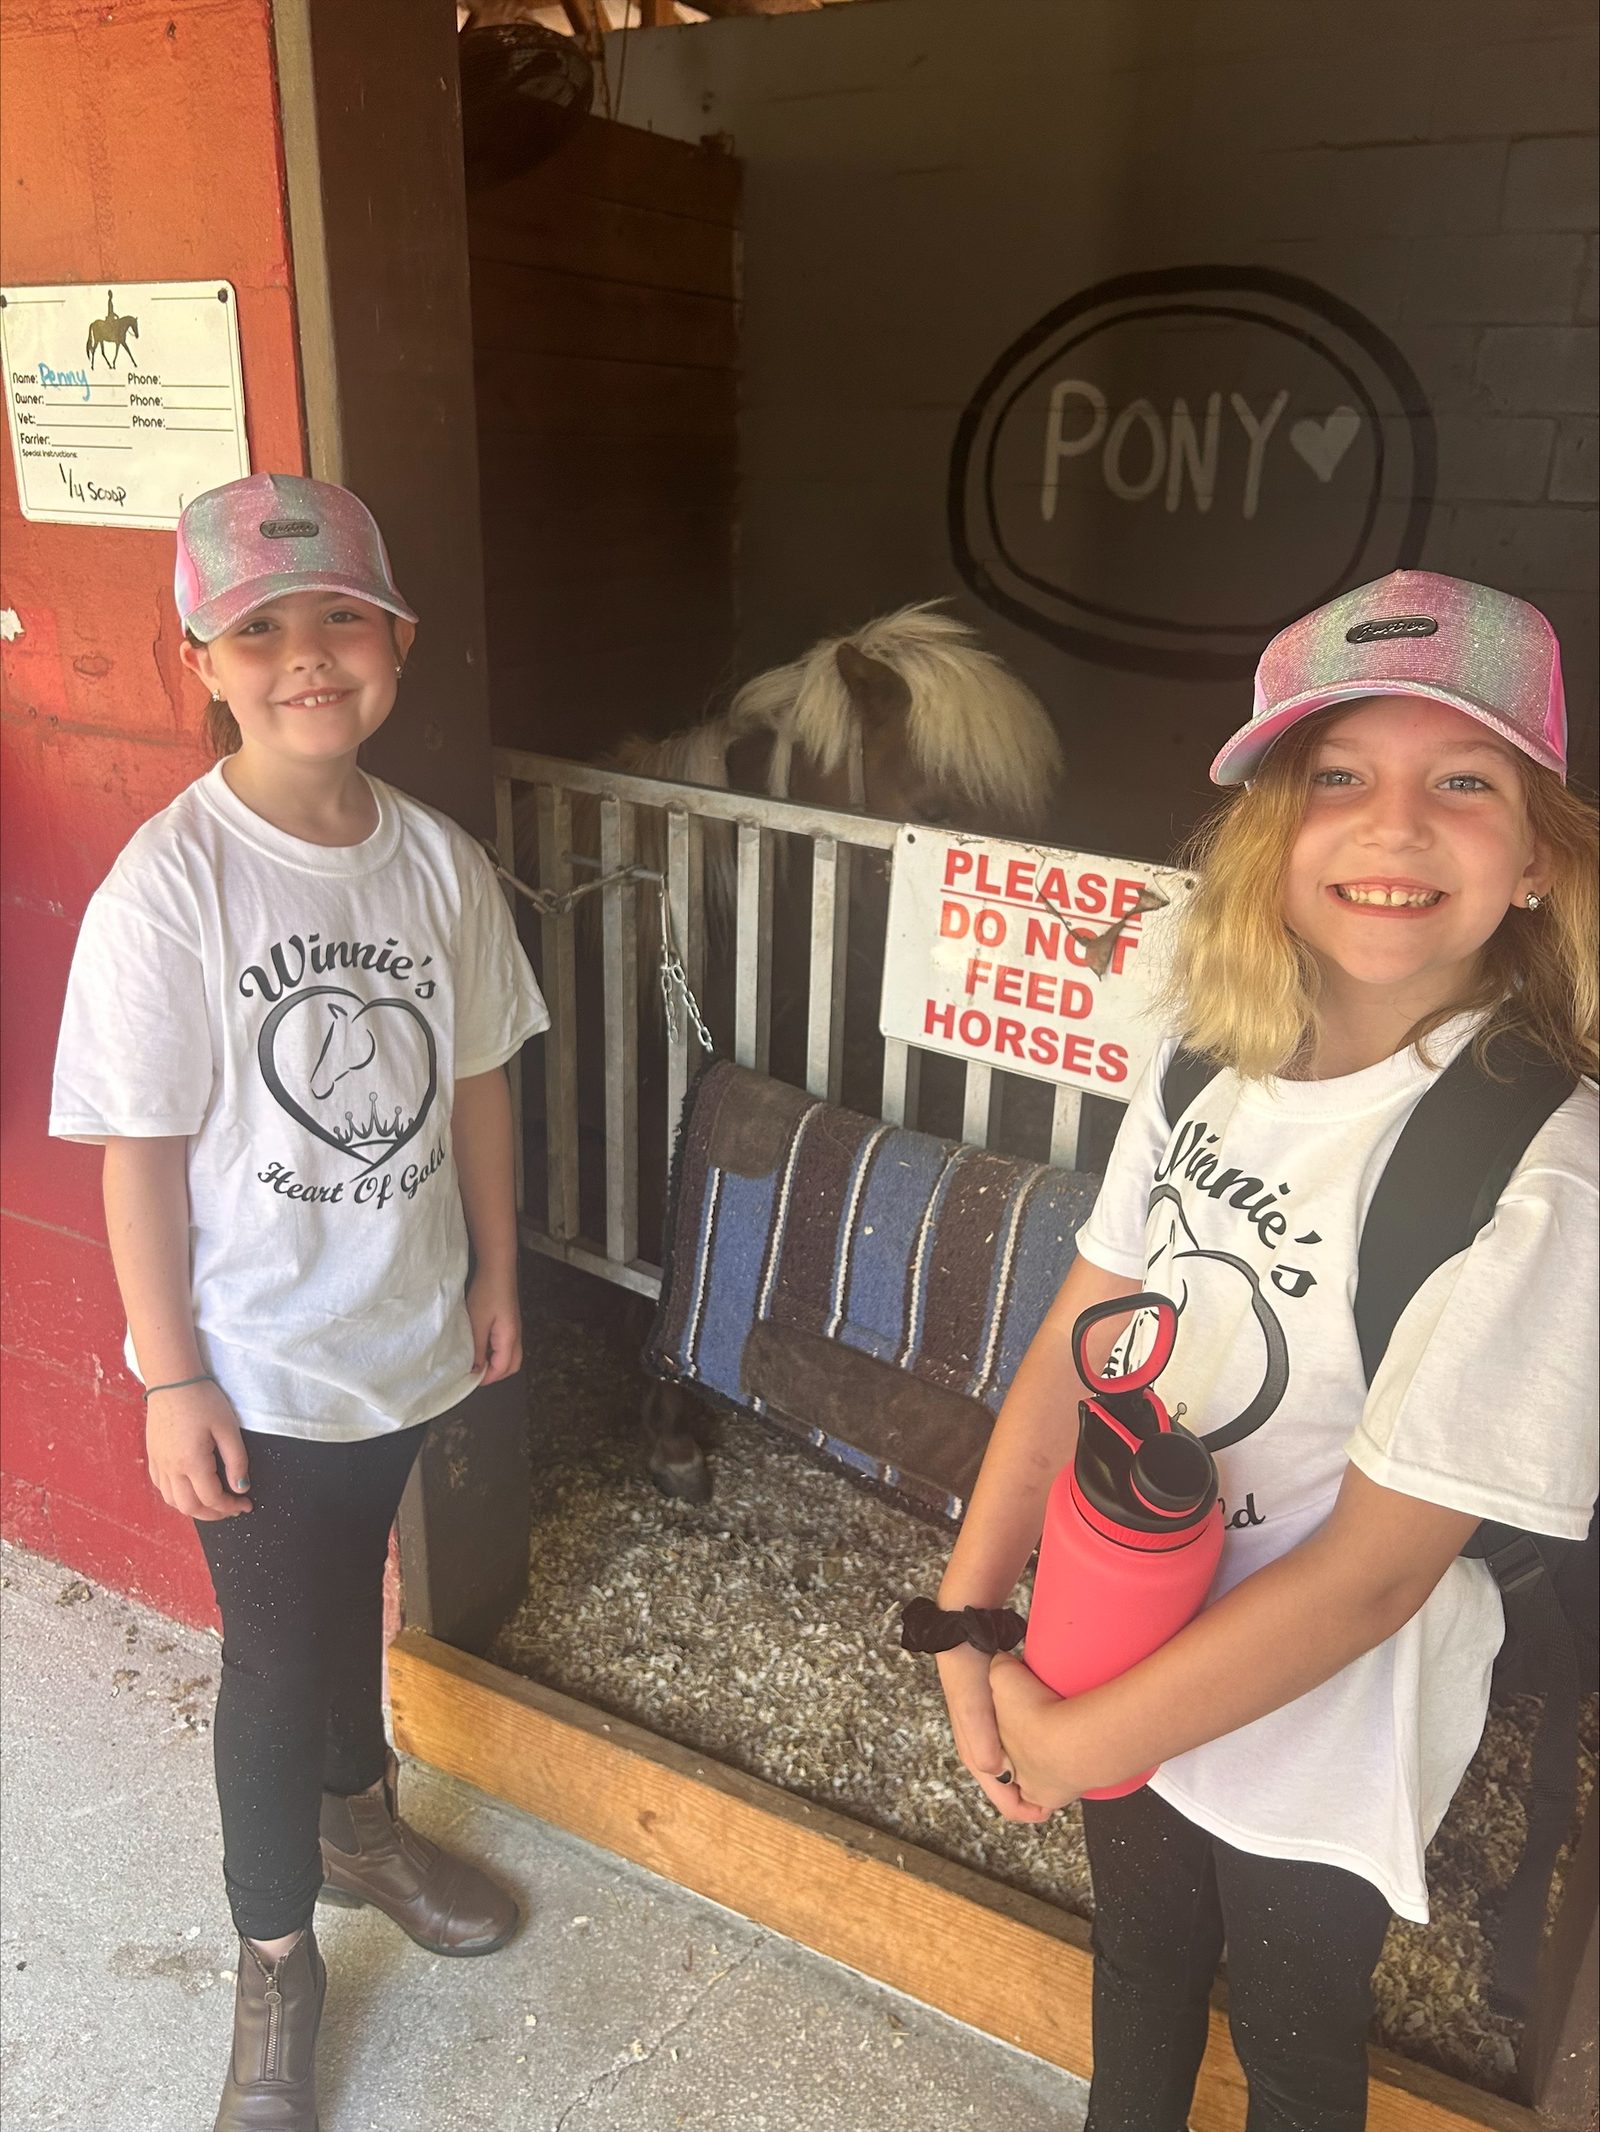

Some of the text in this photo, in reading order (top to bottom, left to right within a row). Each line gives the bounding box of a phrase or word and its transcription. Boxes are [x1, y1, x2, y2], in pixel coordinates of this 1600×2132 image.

[15, 392, 44, 405] Owner:
[38, 361, 91, 402] Penny
[127, 372, 161, 385] Phone:
[130, 393, 163, 407] Phone:
[17, 412, 36, 425] Vet:
[20, 433, 51, 446] Farrier:
[132, 415, 166, 428] Phone:
[1041, 379, 1290, 522] PONY
[943, 848, 1147, 922] PLEASE
[939, 900, 1139, 976] DO NOT
[239, 932, 437, 1003] Winnie's
[964, 957, 1094, 1021] FEED
[923, 998, 1129, 1084] HORSES
[257, 1139, 446, 1210] Heart Of Gold
